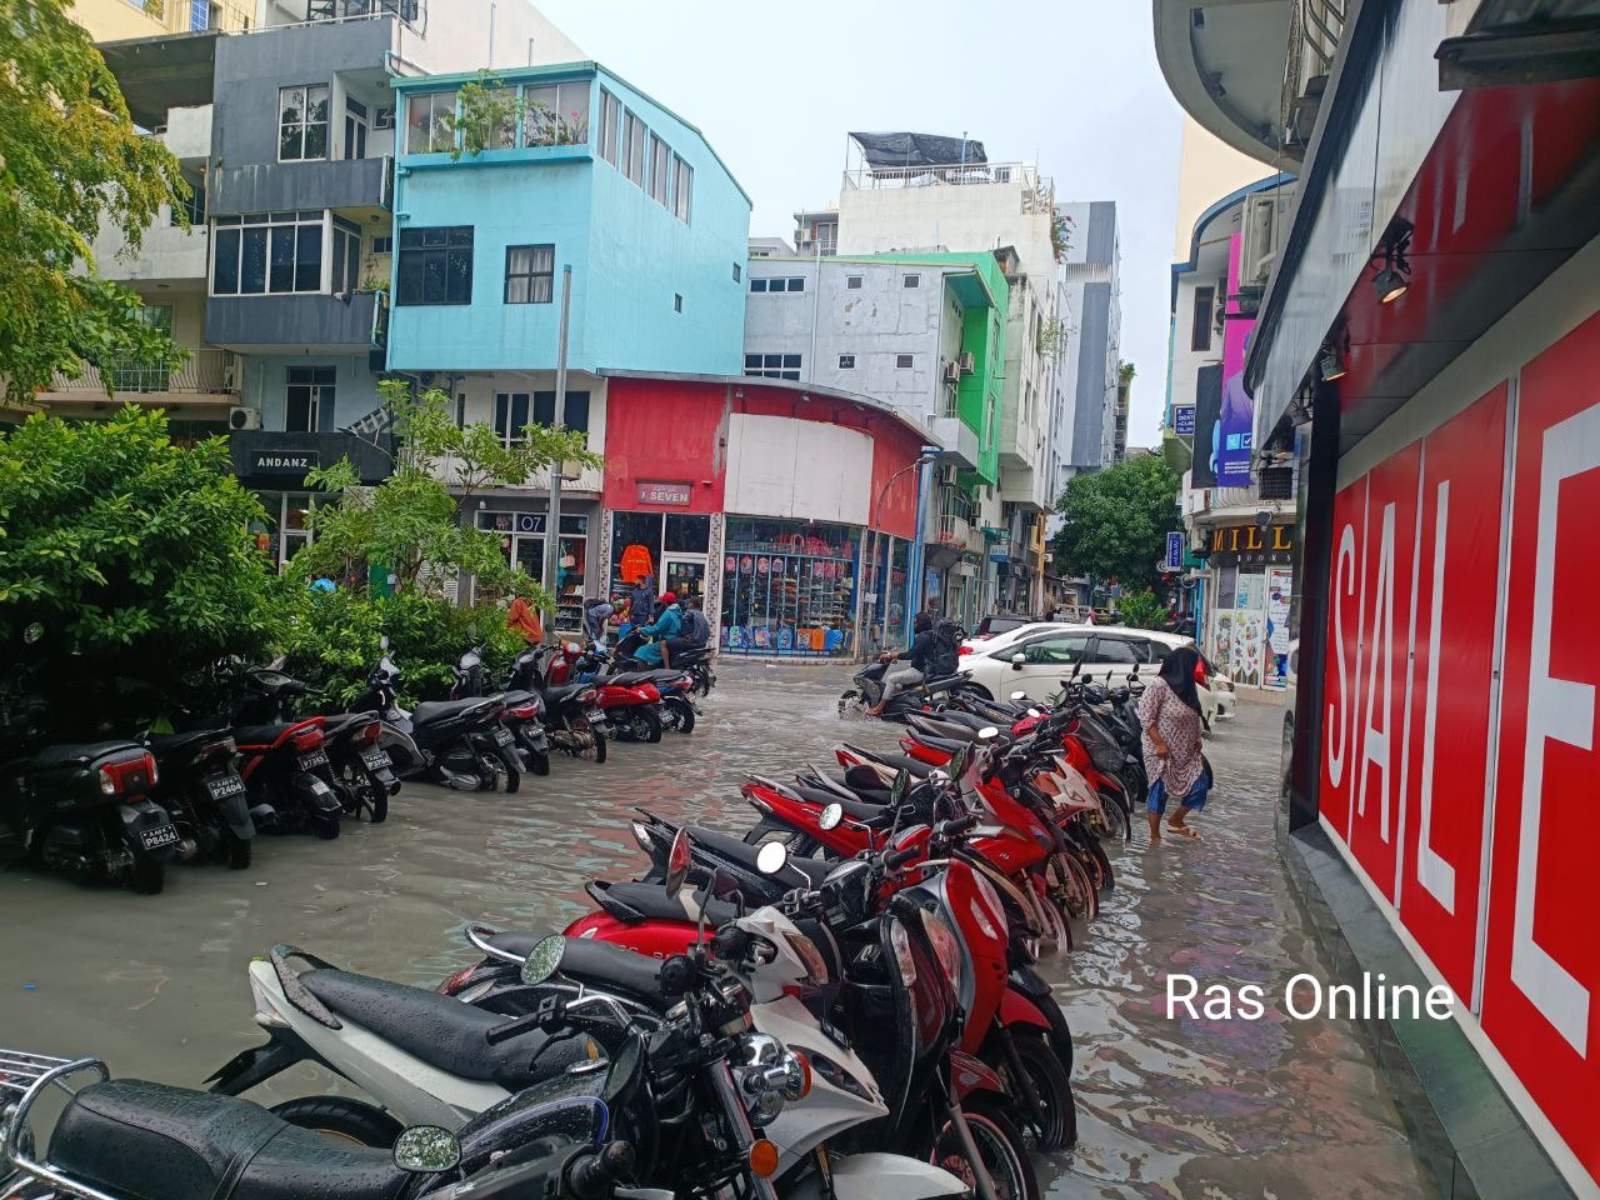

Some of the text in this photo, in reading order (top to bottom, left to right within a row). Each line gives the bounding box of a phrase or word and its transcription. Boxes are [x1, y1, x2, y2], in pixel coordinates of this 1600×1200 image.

[257, 457, 308, 467] ANDANZ
[650, 491, 689, 503] SEVEN
[1328, 403, 1600, 1061] SALE
